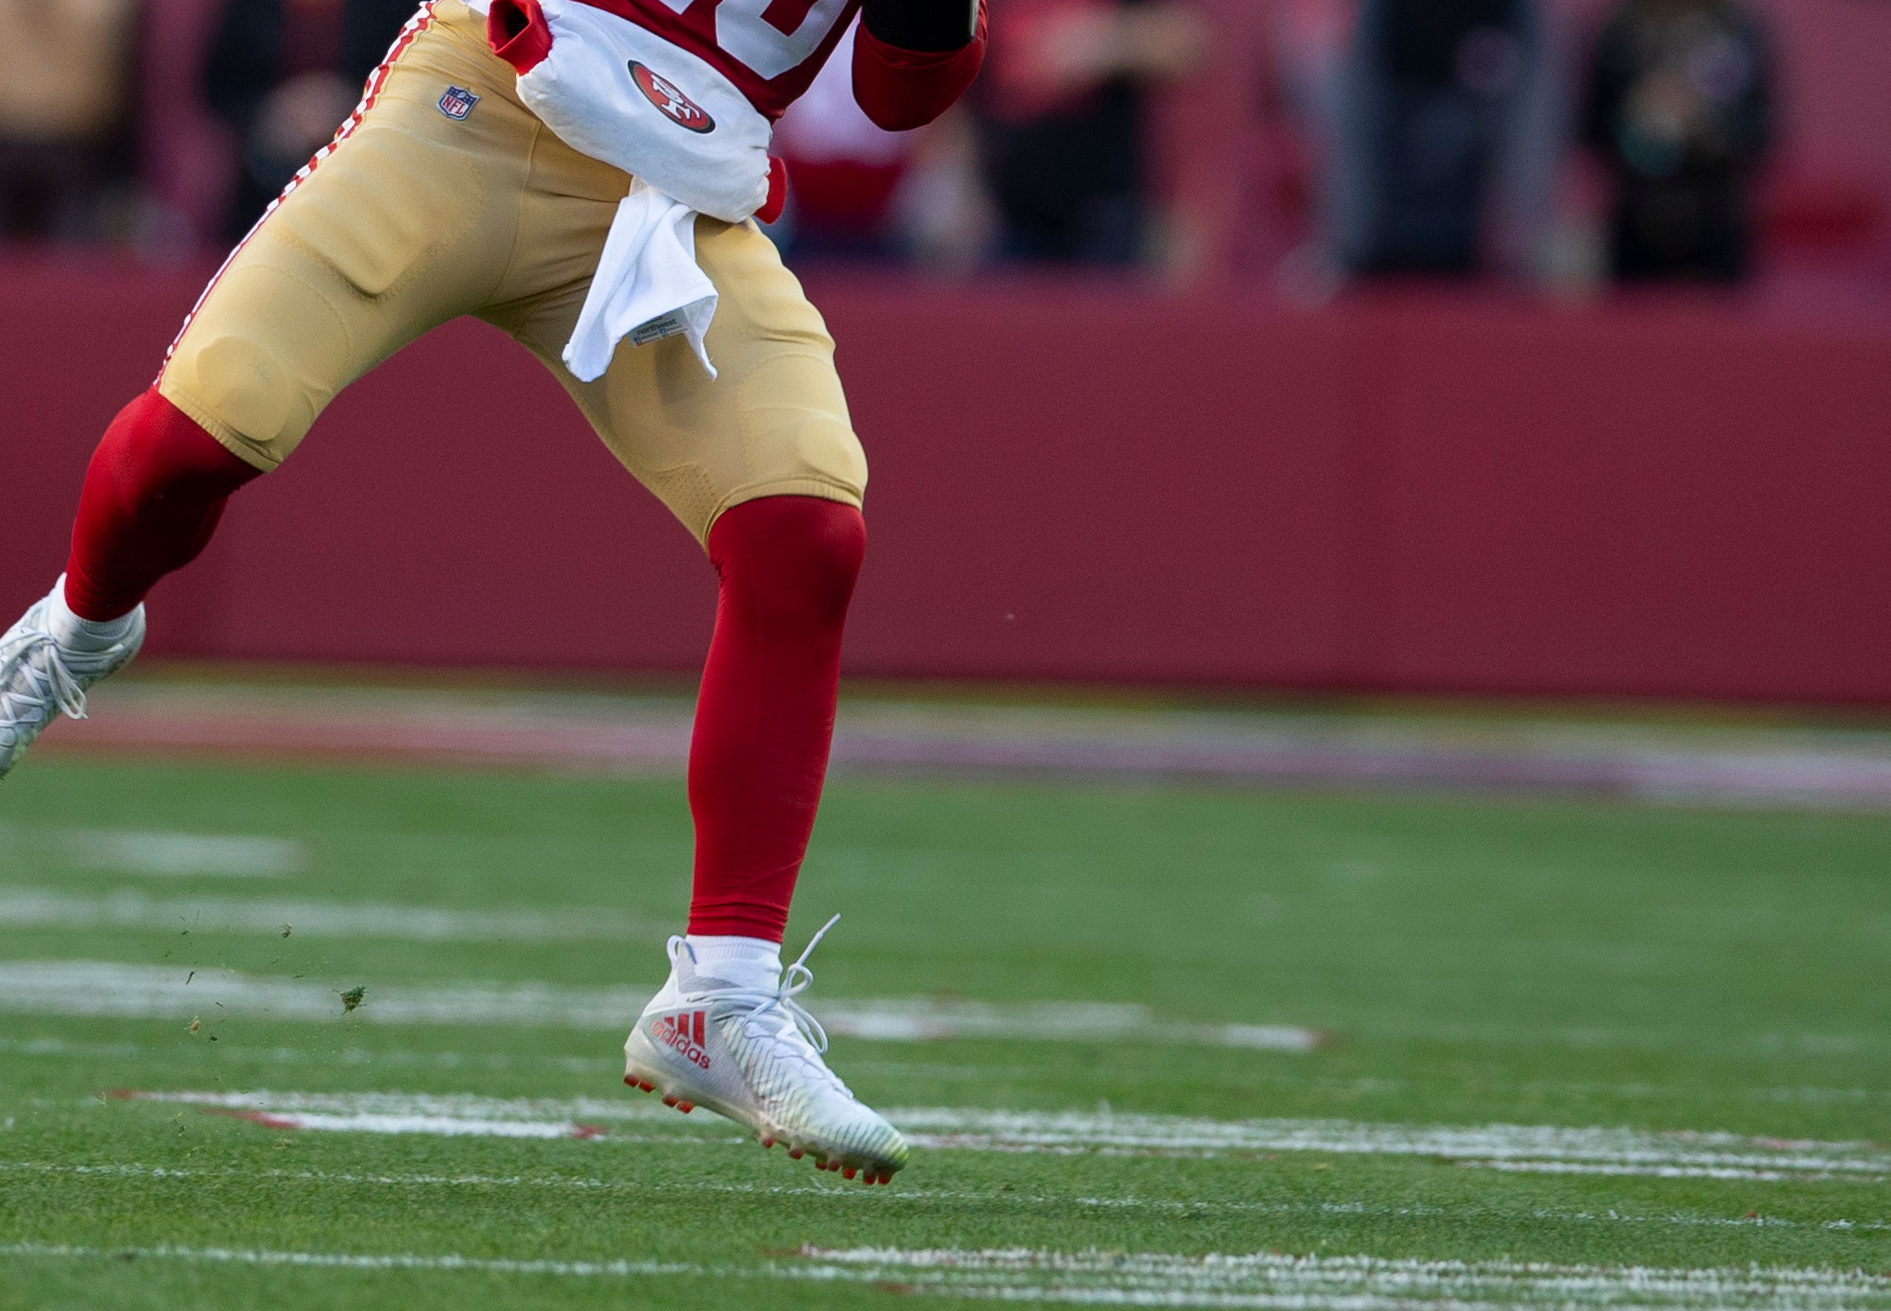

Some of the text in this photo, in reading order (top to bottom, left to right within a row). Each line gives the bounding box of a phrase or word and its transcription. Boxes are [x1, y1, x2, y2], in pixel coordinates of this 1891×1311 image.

[442, 95, 465, 115] NFL
[636, 318, 677, 336] northwest
[651, 1021, 711, 1070] adidas
